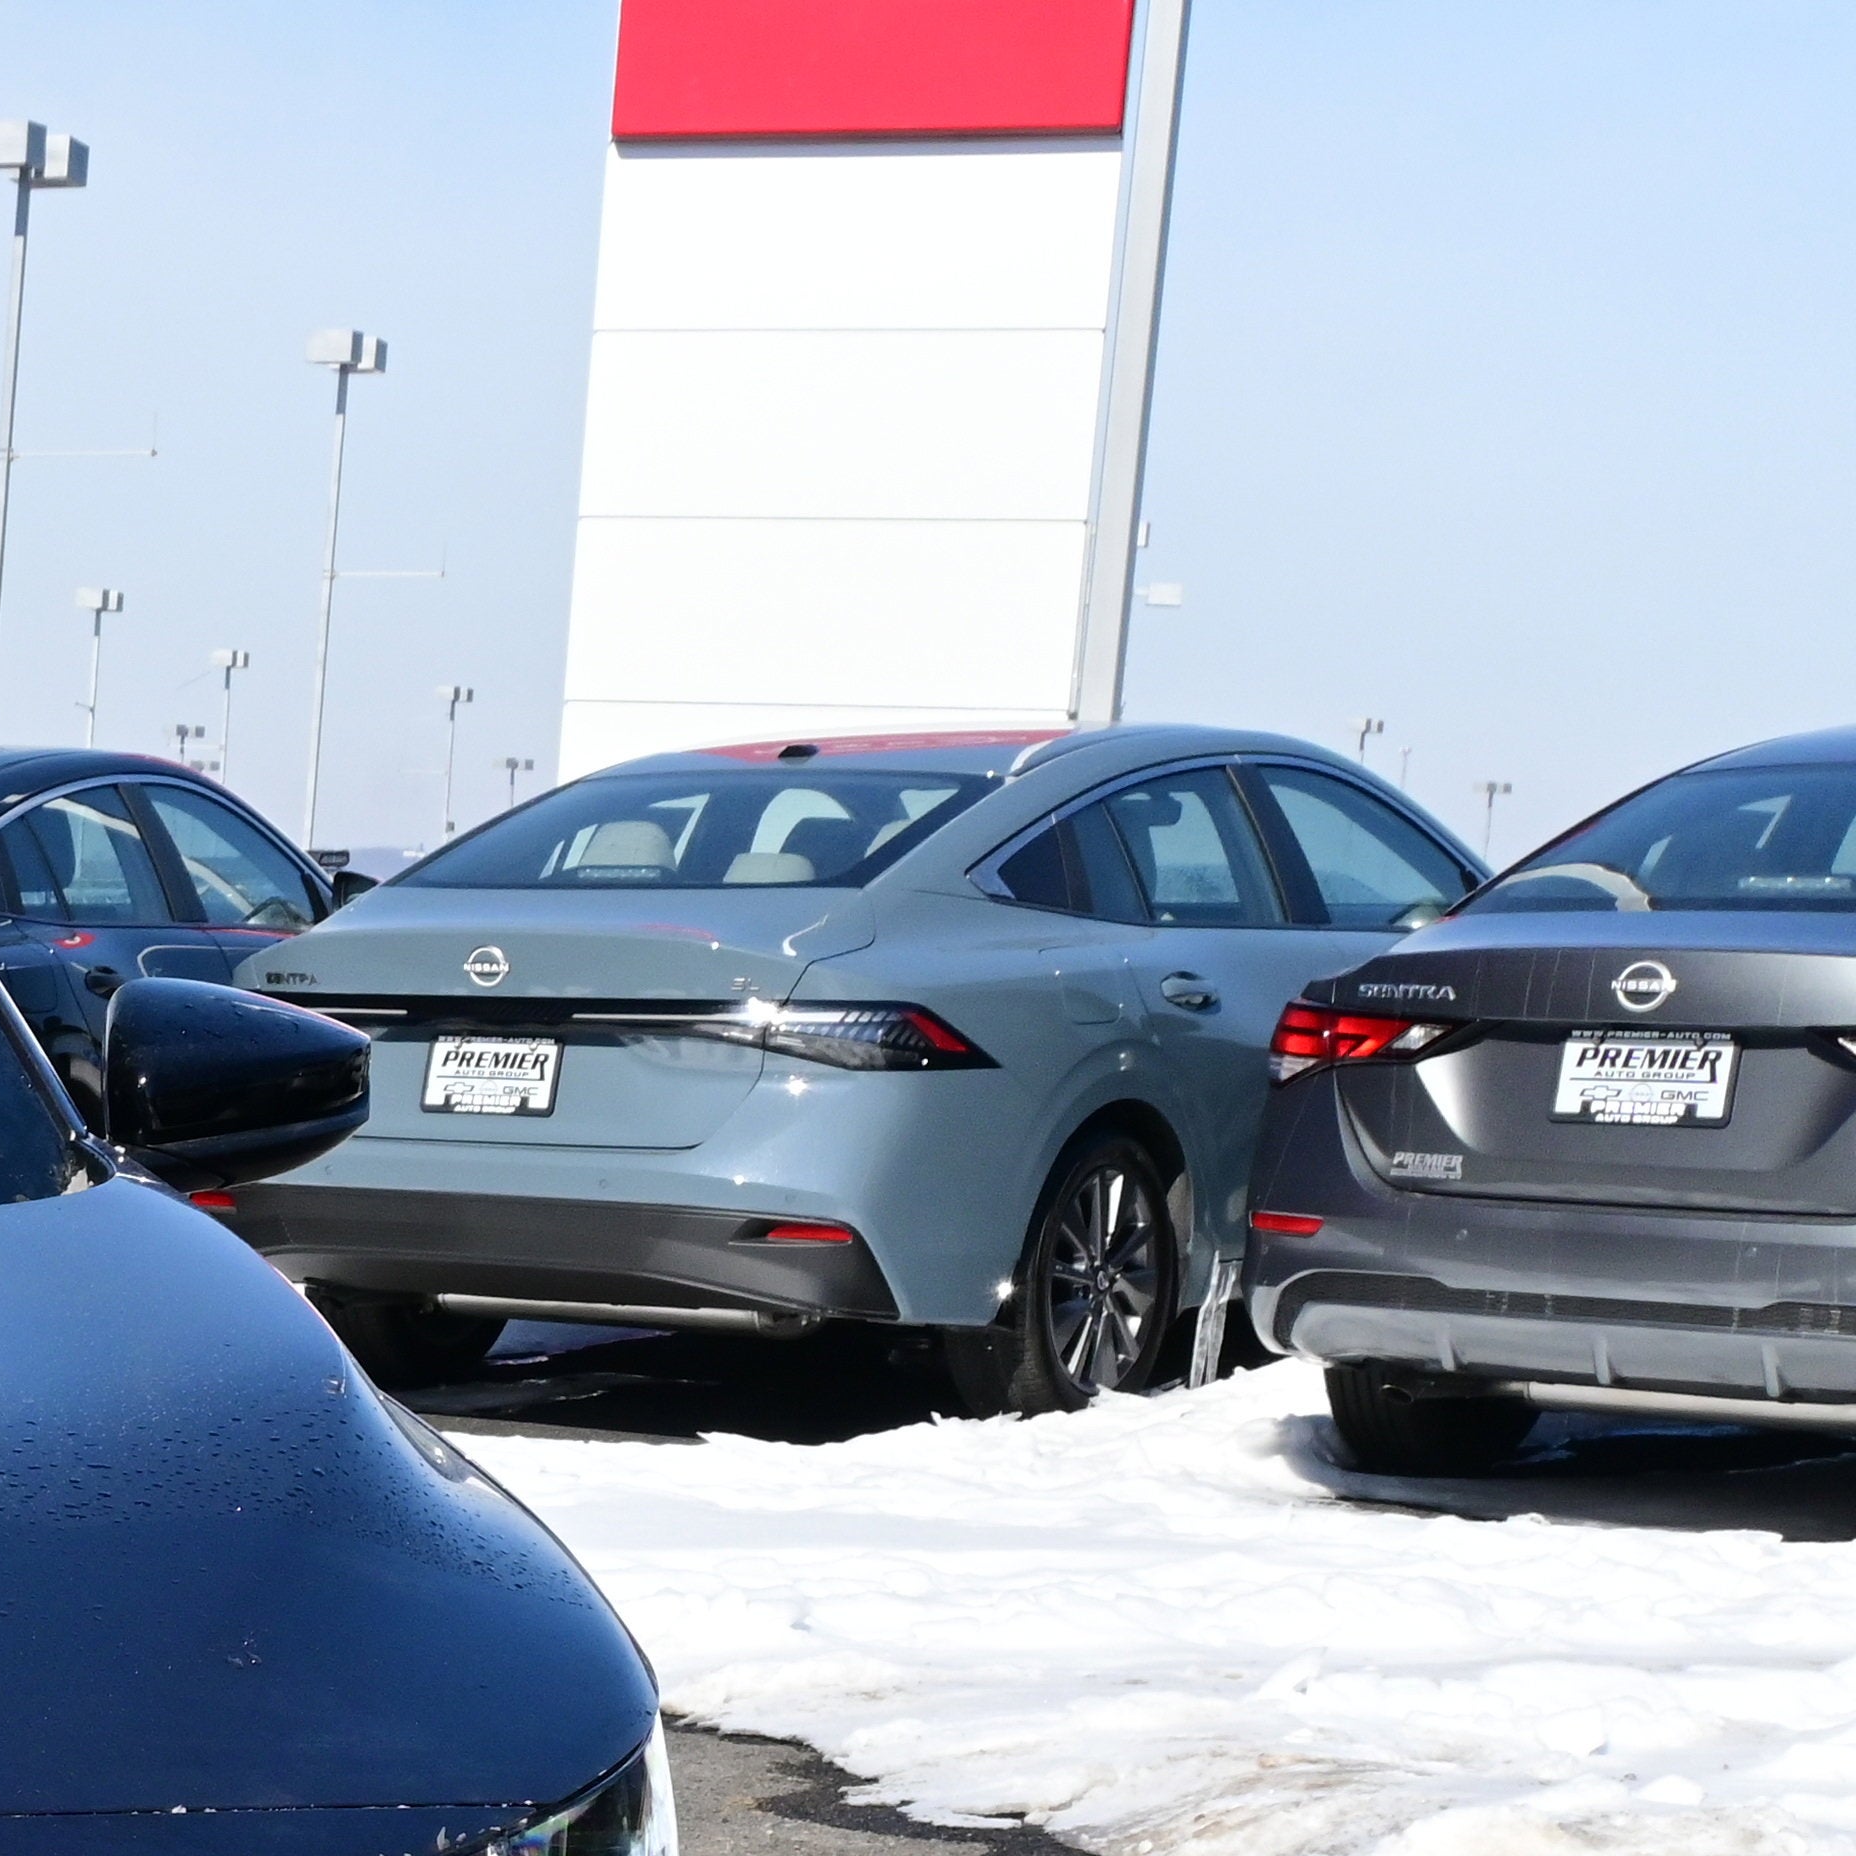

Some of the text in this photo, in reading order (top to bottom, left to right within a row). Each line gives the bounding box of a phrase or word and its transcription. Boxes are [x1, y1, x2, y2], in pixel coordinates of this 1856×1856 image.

[463, 963, 510, 972] NISSAN
[1358, 983, 1456, 1001] SENTRA
[1571, 1029, 1731, 1040] WWW.PREMIER-AUTOCOM
[442, 1050, 550, 1080] PREMIER
[1576, 1047, 1722, 1083] PREMIER
[1594, 1070, 1696, 1079] AUTO GROUP
[502, 1086, 539, 1096] GMC
[1660, 1089, 1709, 1101] GMC
[450, 1093, 521, 1107] PREMIER
[1590, 1100, 1687, 1116] PREMIER
[1595, 1113, 1630, 1122] AUTO
